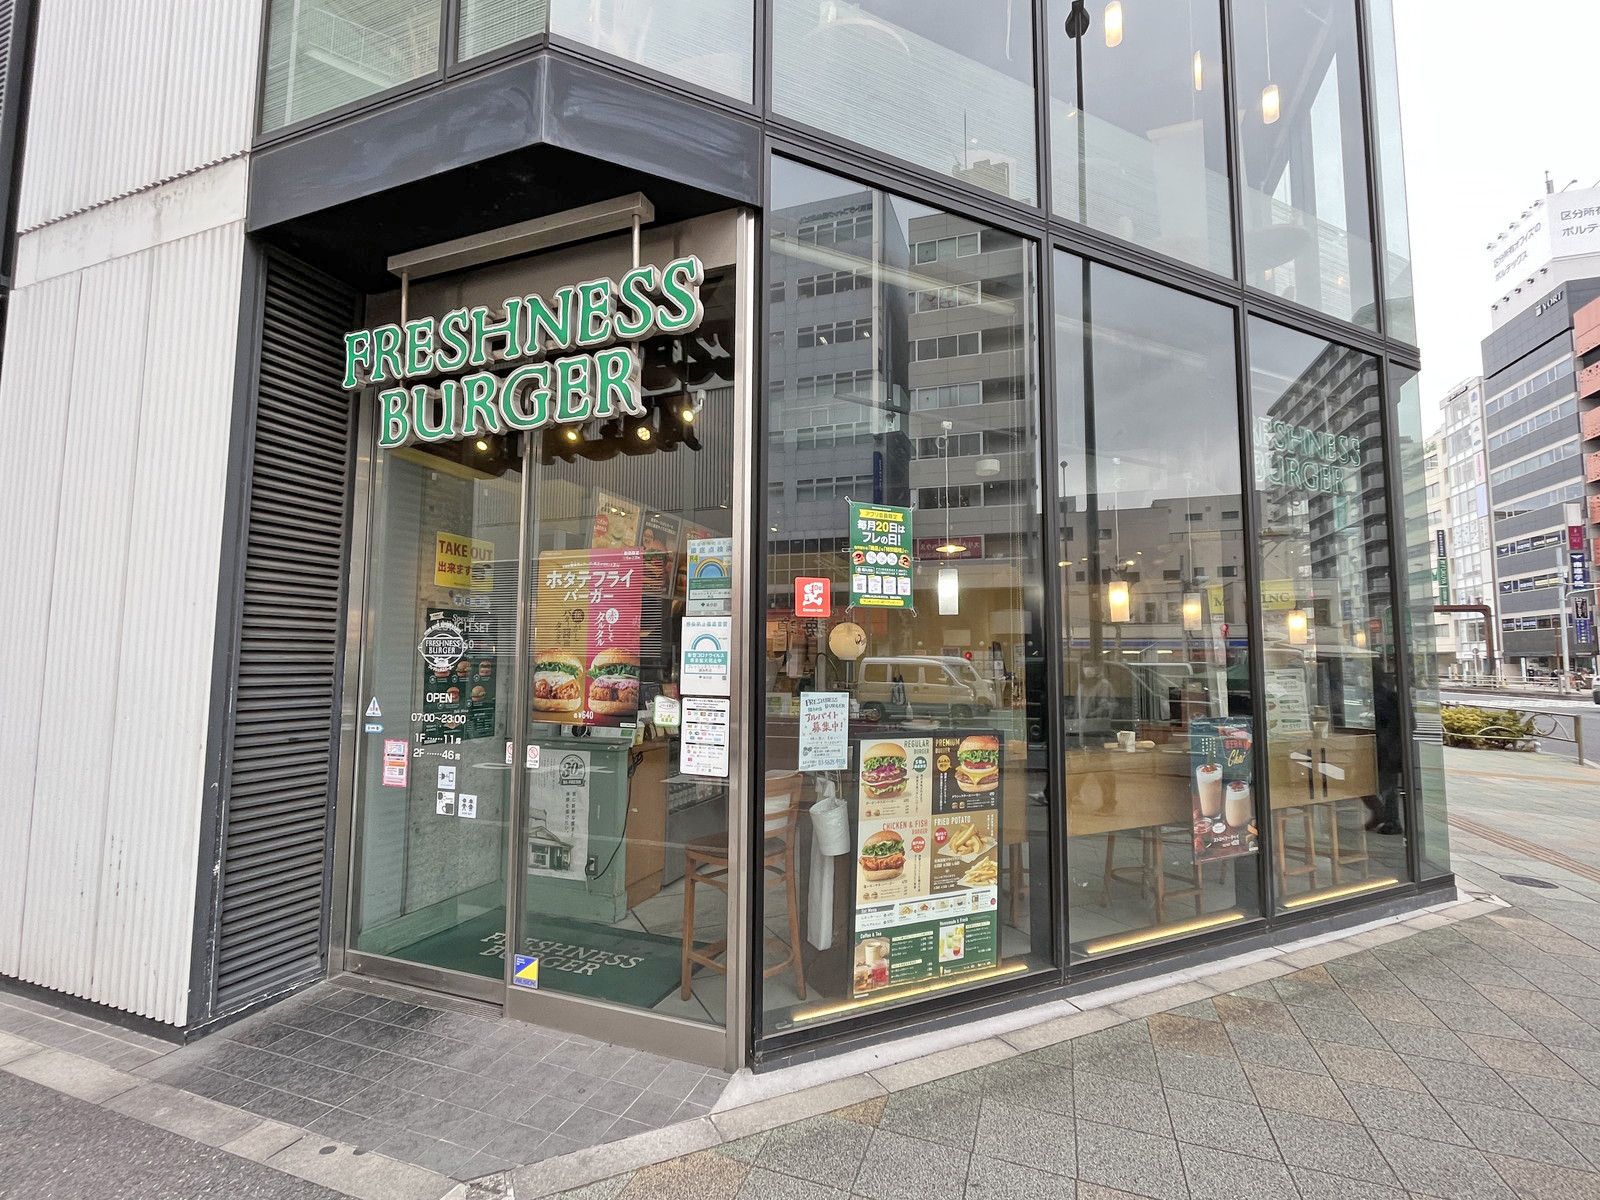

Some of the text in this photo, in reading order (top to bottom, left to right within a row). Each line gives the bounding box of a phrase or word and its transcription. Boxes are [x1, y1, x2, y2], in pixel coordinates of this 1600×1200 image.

[343, 254, 705, 390] FRESHNESS
[378, 346, 647, 449] BURGER
[857, 519, 906, 533] 毎月20日は
[438, 540, 494, 561] TAKE OUT
[546, 569, 634, 589] ホタテフライ
[563, 588, 614, 604] バーガー
[595, 611, 606, 646] タルタル
[426, 639, 461, 648] FRESHNESS
[428, 646, 456, 654] BURGER
[426, 692, 453, 703] OPEN
[805, 711, 839, 723] アルバイト
[812, 721, 844, 733] 募集中!
[903, 739, 930, 748] REGULAR
[935, 738, 961, 747] PREMIUM
[413, 748, 425, 758] 2F
[883, 821, 908, 830] CHICKEN
[915, 820, 928, 828] FISH
[934, 815, 971, 826] FRIED POTATO
